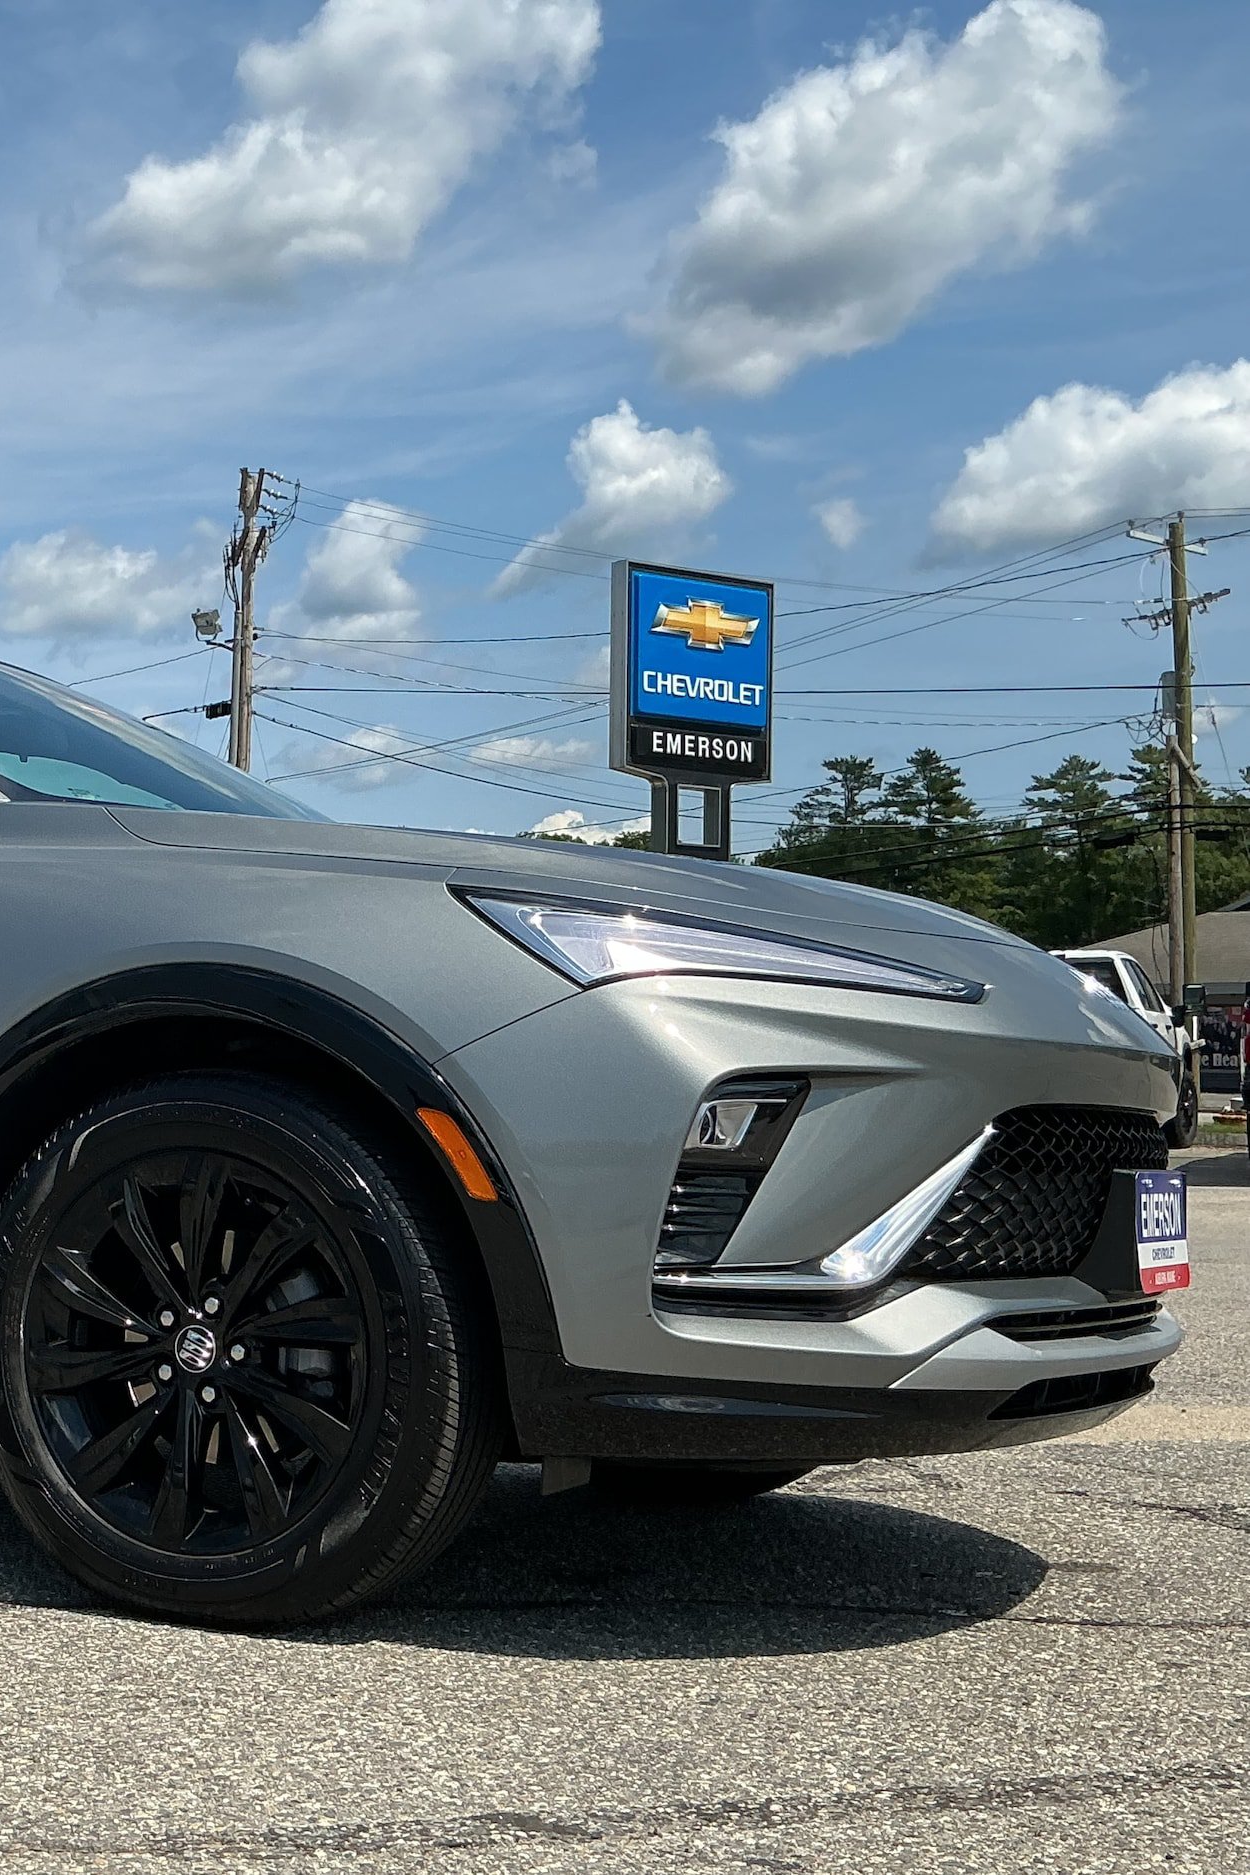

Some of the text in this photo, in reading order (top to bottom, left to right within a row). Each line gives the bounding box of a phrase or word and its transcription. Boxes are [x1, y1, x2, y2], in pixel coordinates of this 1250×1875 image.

[643, 669, 764, 706] CHEVROLET
[652, 731, 752, 763] EMERSON
[1140, 1192, 1182, 1238] EMERSON
